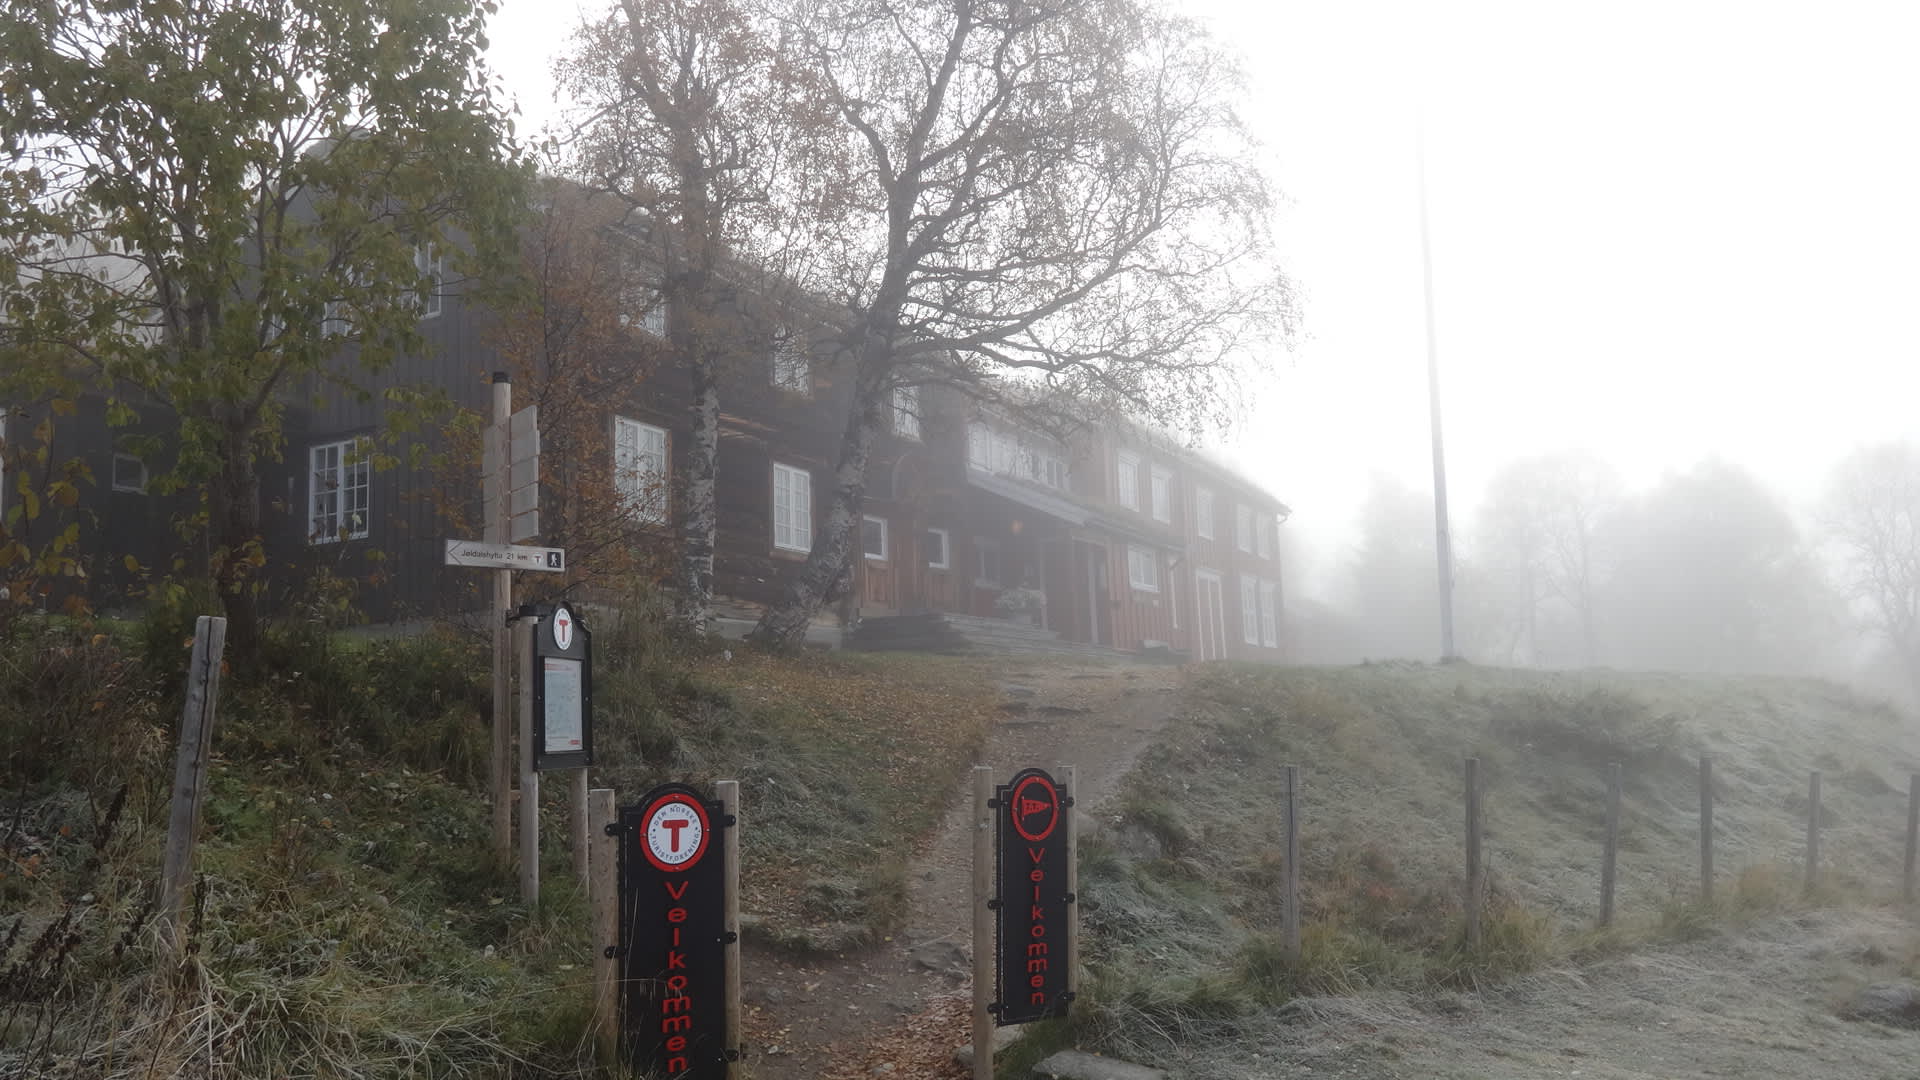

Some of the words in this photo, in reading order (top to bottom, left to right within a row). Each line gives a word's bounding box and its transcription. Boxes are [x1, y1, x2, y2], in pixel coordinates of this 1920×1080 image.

[506, 552, 514, 560] 21
[559, 619, 569, 642] T
[653, 811, 667, 826] DEN
[670, 806, 697, 824] NORSKE
[652, 833, 700, 861] TURISTFORENING
[662, 819, 689, 853] T
[1027, 848, 1048, 1006] Velkommen
[662, 881, 692, 1074] Velkommen
